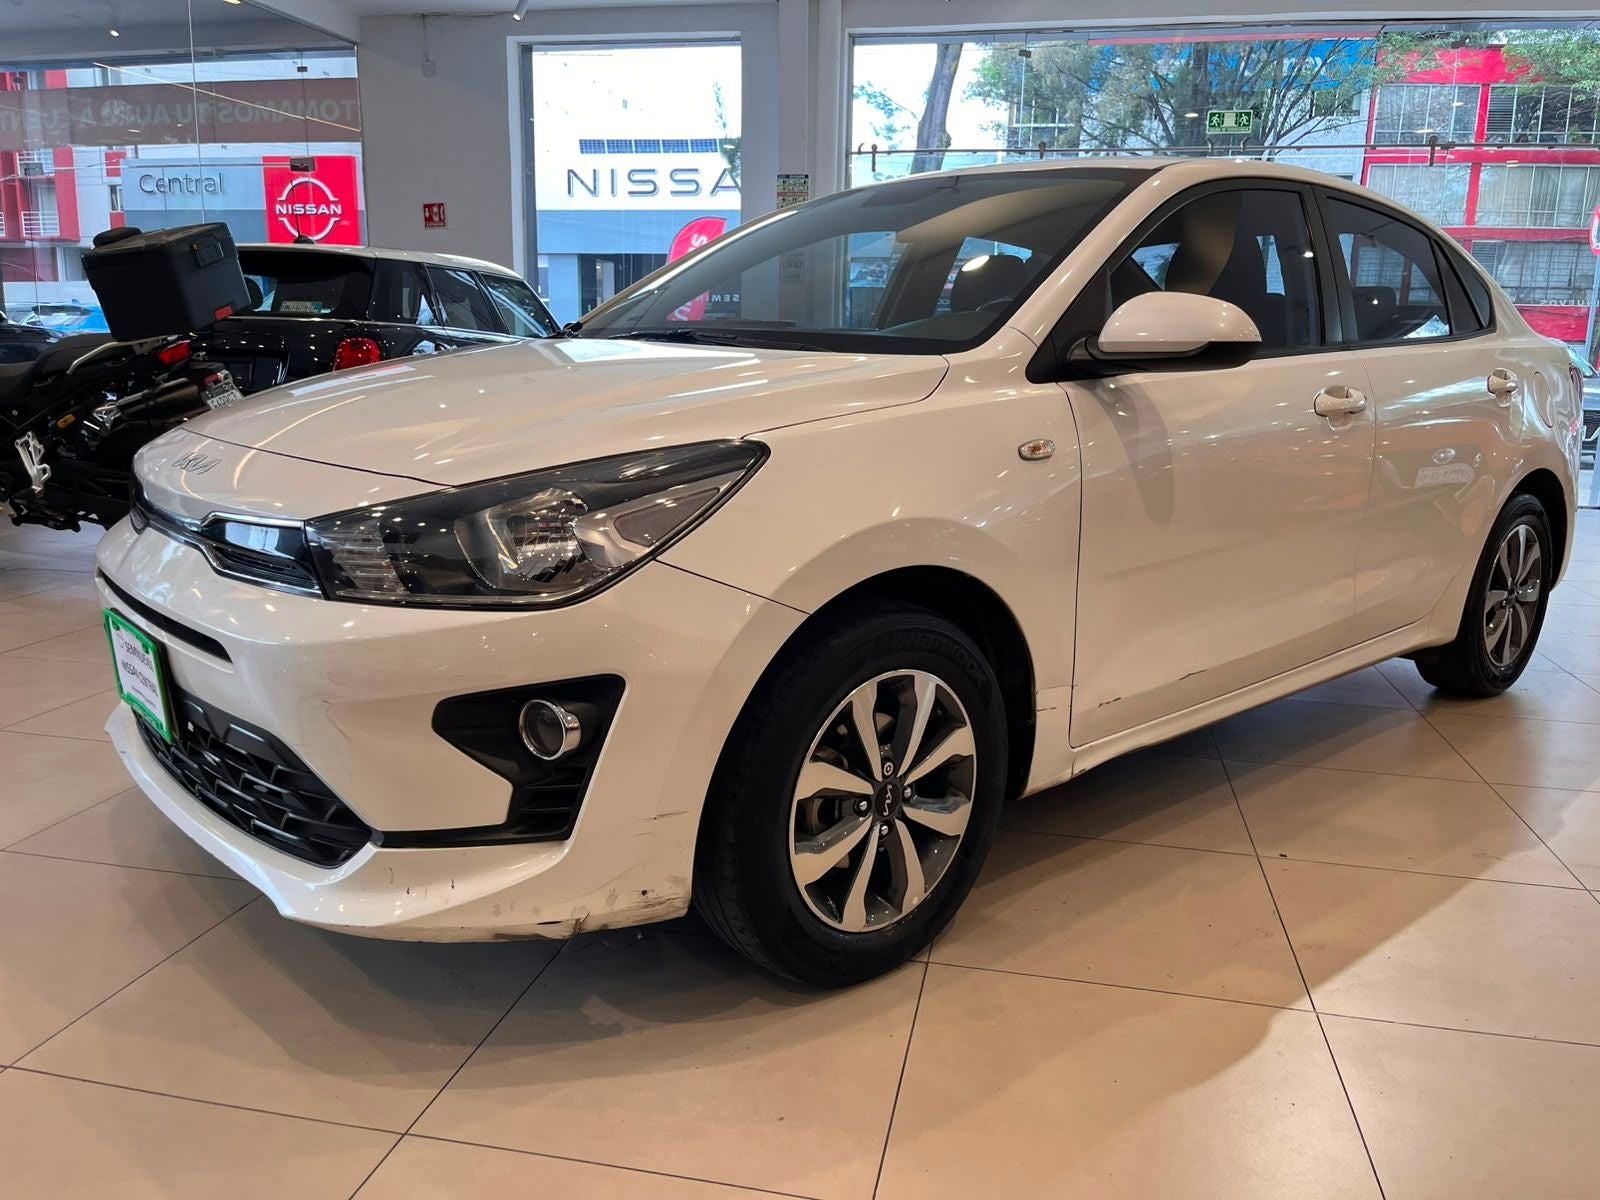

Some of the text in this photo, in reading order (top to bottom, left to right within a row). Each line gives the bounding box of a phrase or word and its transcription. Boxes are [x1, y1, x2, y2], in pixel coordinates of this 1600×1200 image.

[138, 172, 225, 195] Central
[567, 168, 741, 197] NISSA
[275, 203, 342, 216] NISSAN
